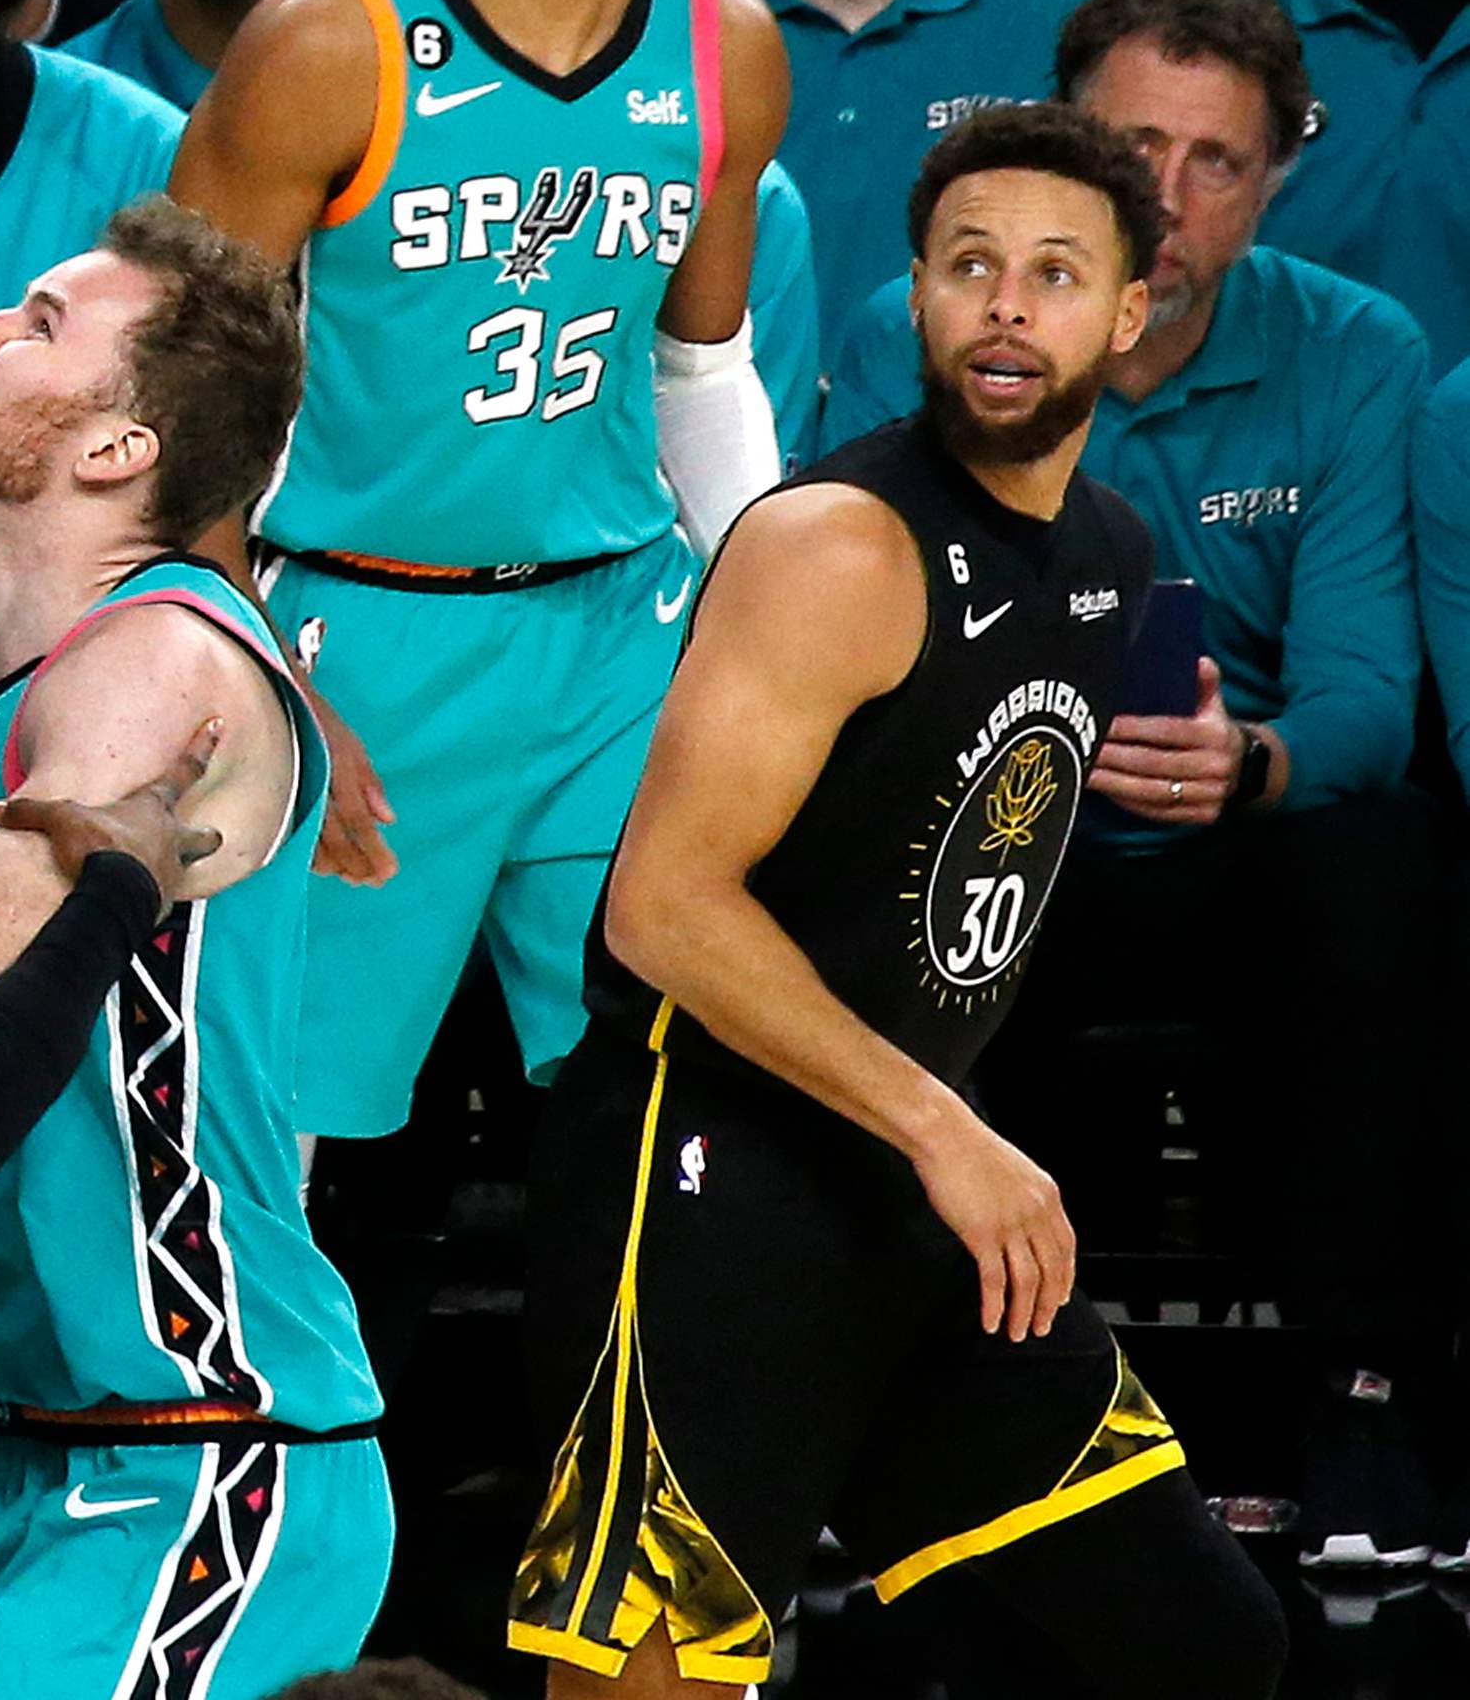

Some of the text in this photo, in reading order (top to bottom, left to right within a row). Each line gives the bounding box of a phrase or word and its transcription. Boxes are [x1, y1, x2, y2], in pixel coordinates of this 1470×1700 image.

[412, 23, 443, 65] 6
[626, 89, 689, 125] Self.
[391, 167, 695, 294] SPURS
[463, 305, 619, 425] 35
[947, 543, 971, 585] 6
[1069, 588, 1119, 617] Rakuten
[956, 679, 1097, 778] WARRIORS
[946, 873, 1025, 976] 30
